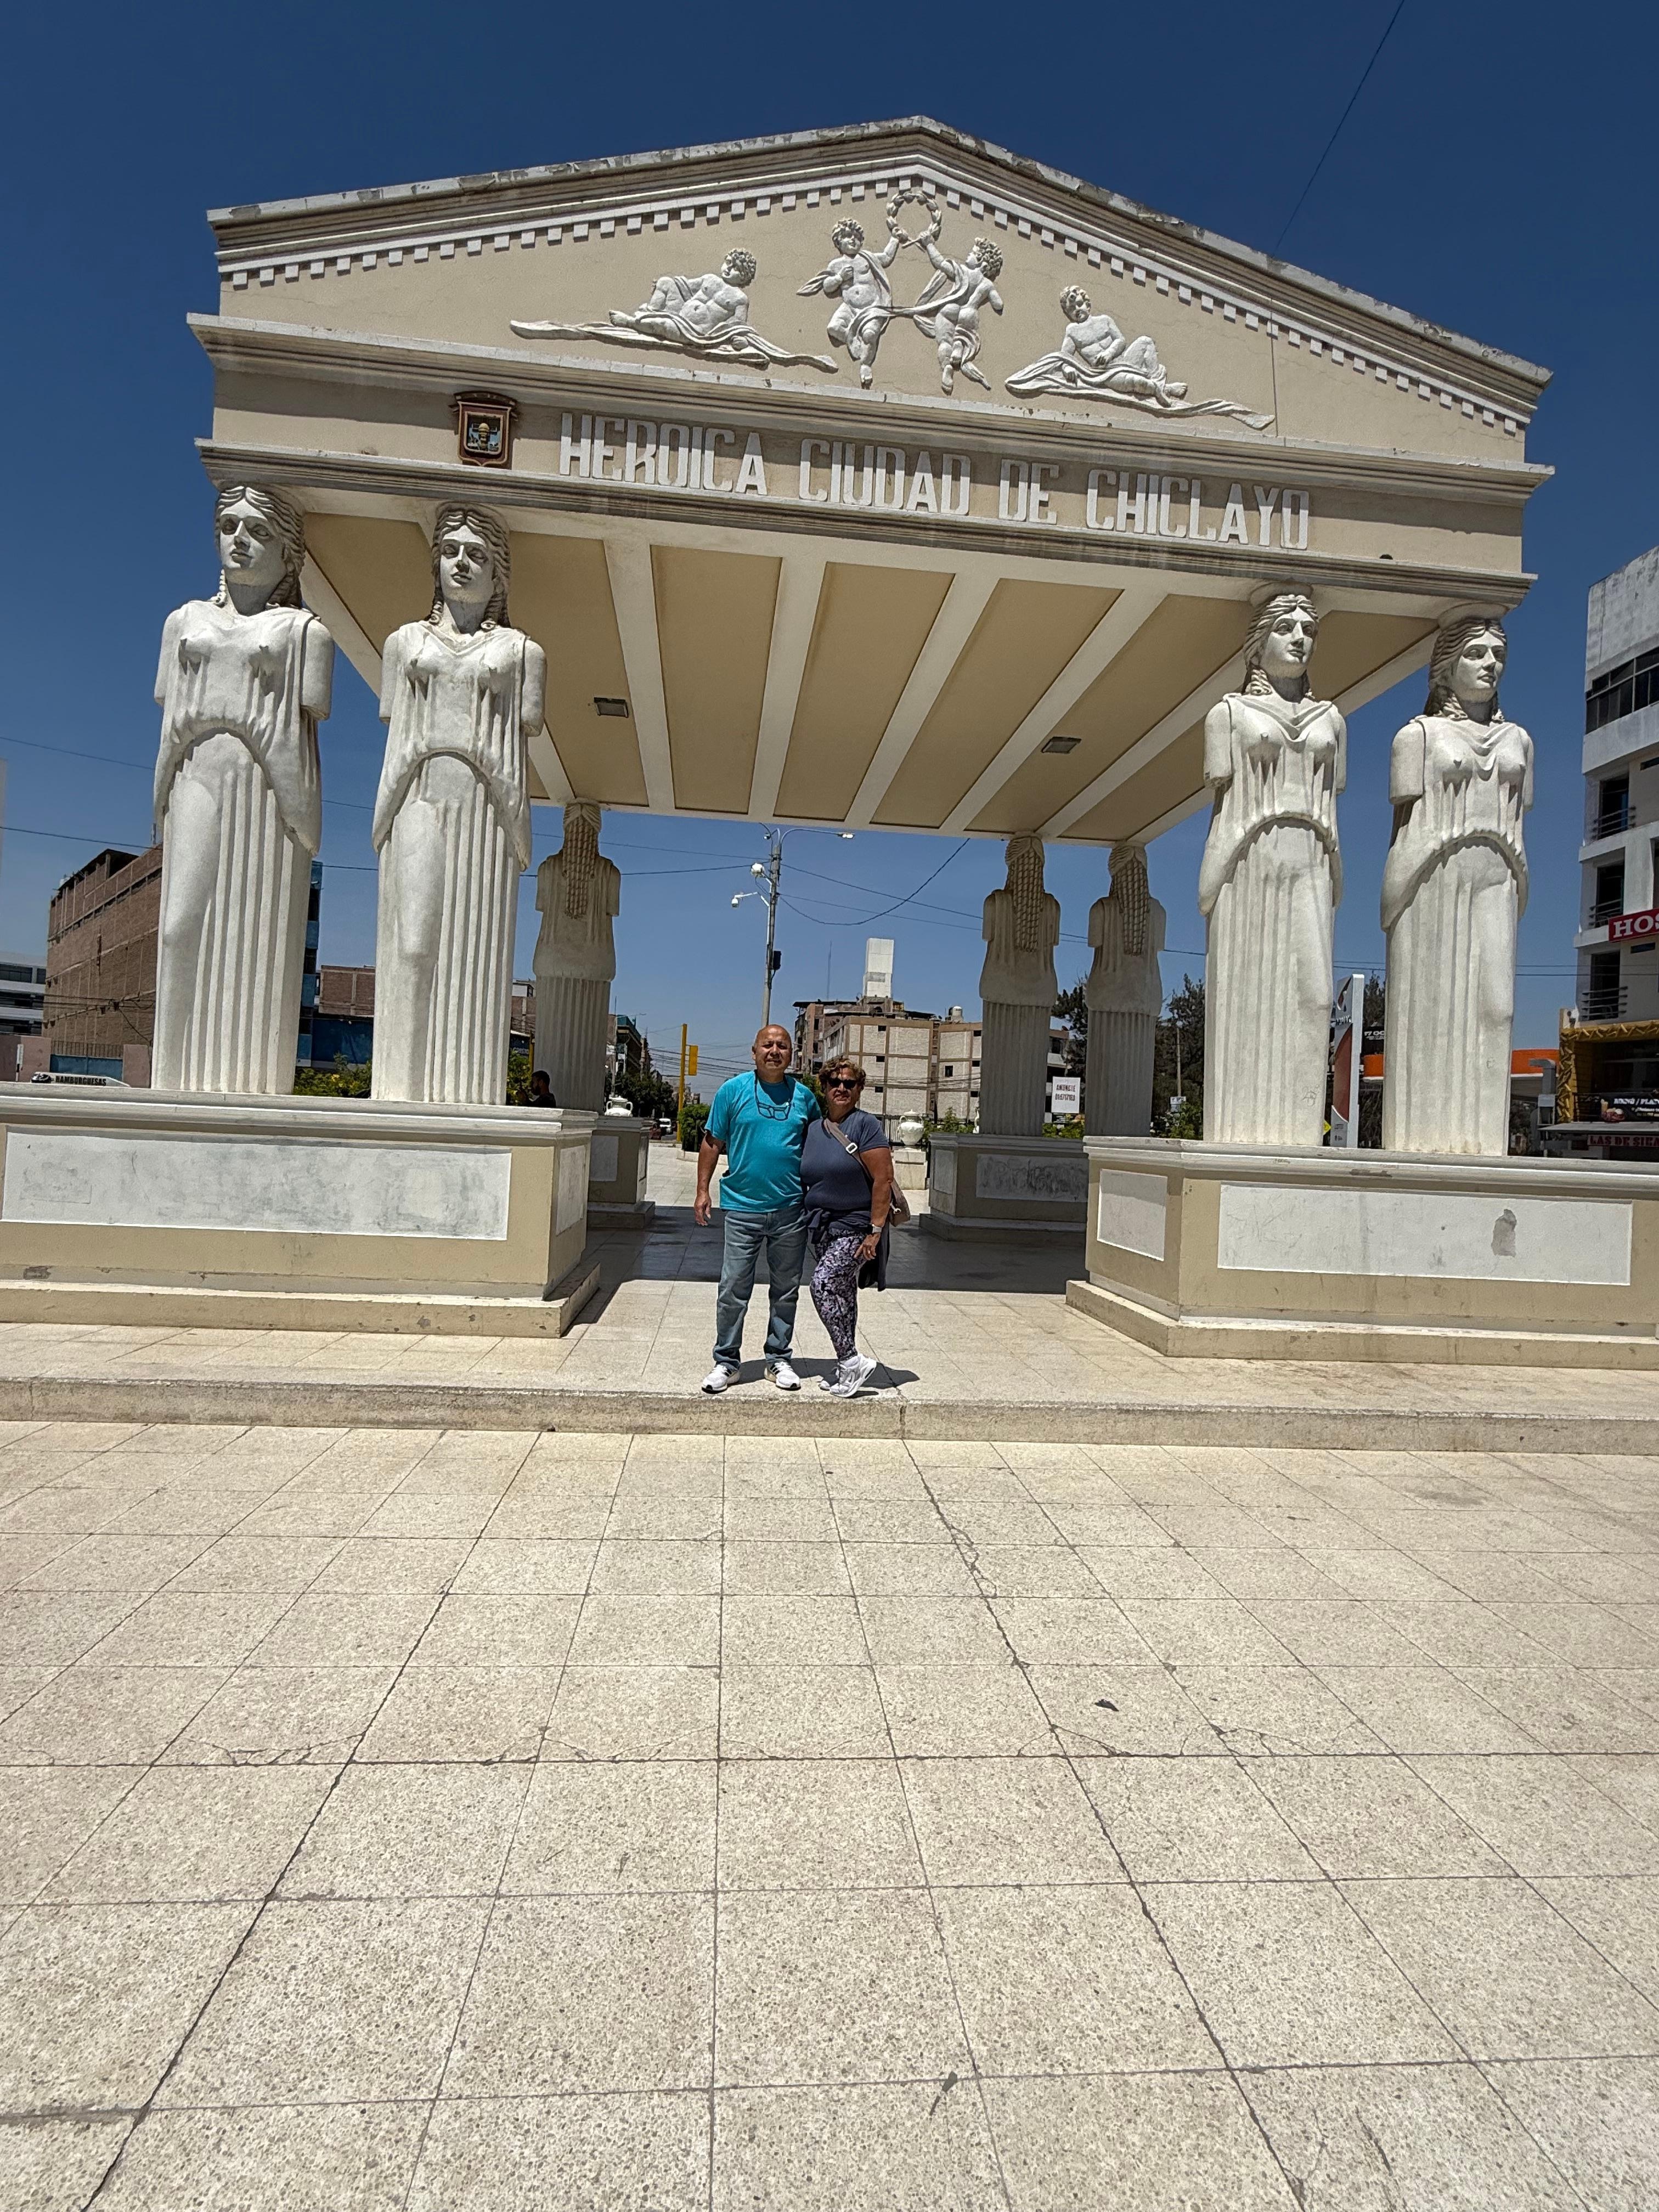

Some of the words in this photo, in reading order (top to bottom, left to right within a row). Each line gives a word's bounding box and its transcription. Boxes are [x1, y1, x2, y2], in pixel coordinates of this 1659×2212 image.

[559, 413, 768, 495] HEROICA
[799, 439, 972, 516] CIUDAD
[998, 459, 1059, 524] DE
[1086, 469, 1310, 550] CHICLAYO
[1613, 913, 1659, 938] HO
[55, 1075, 106, 1086] HAMBURGUESAS
